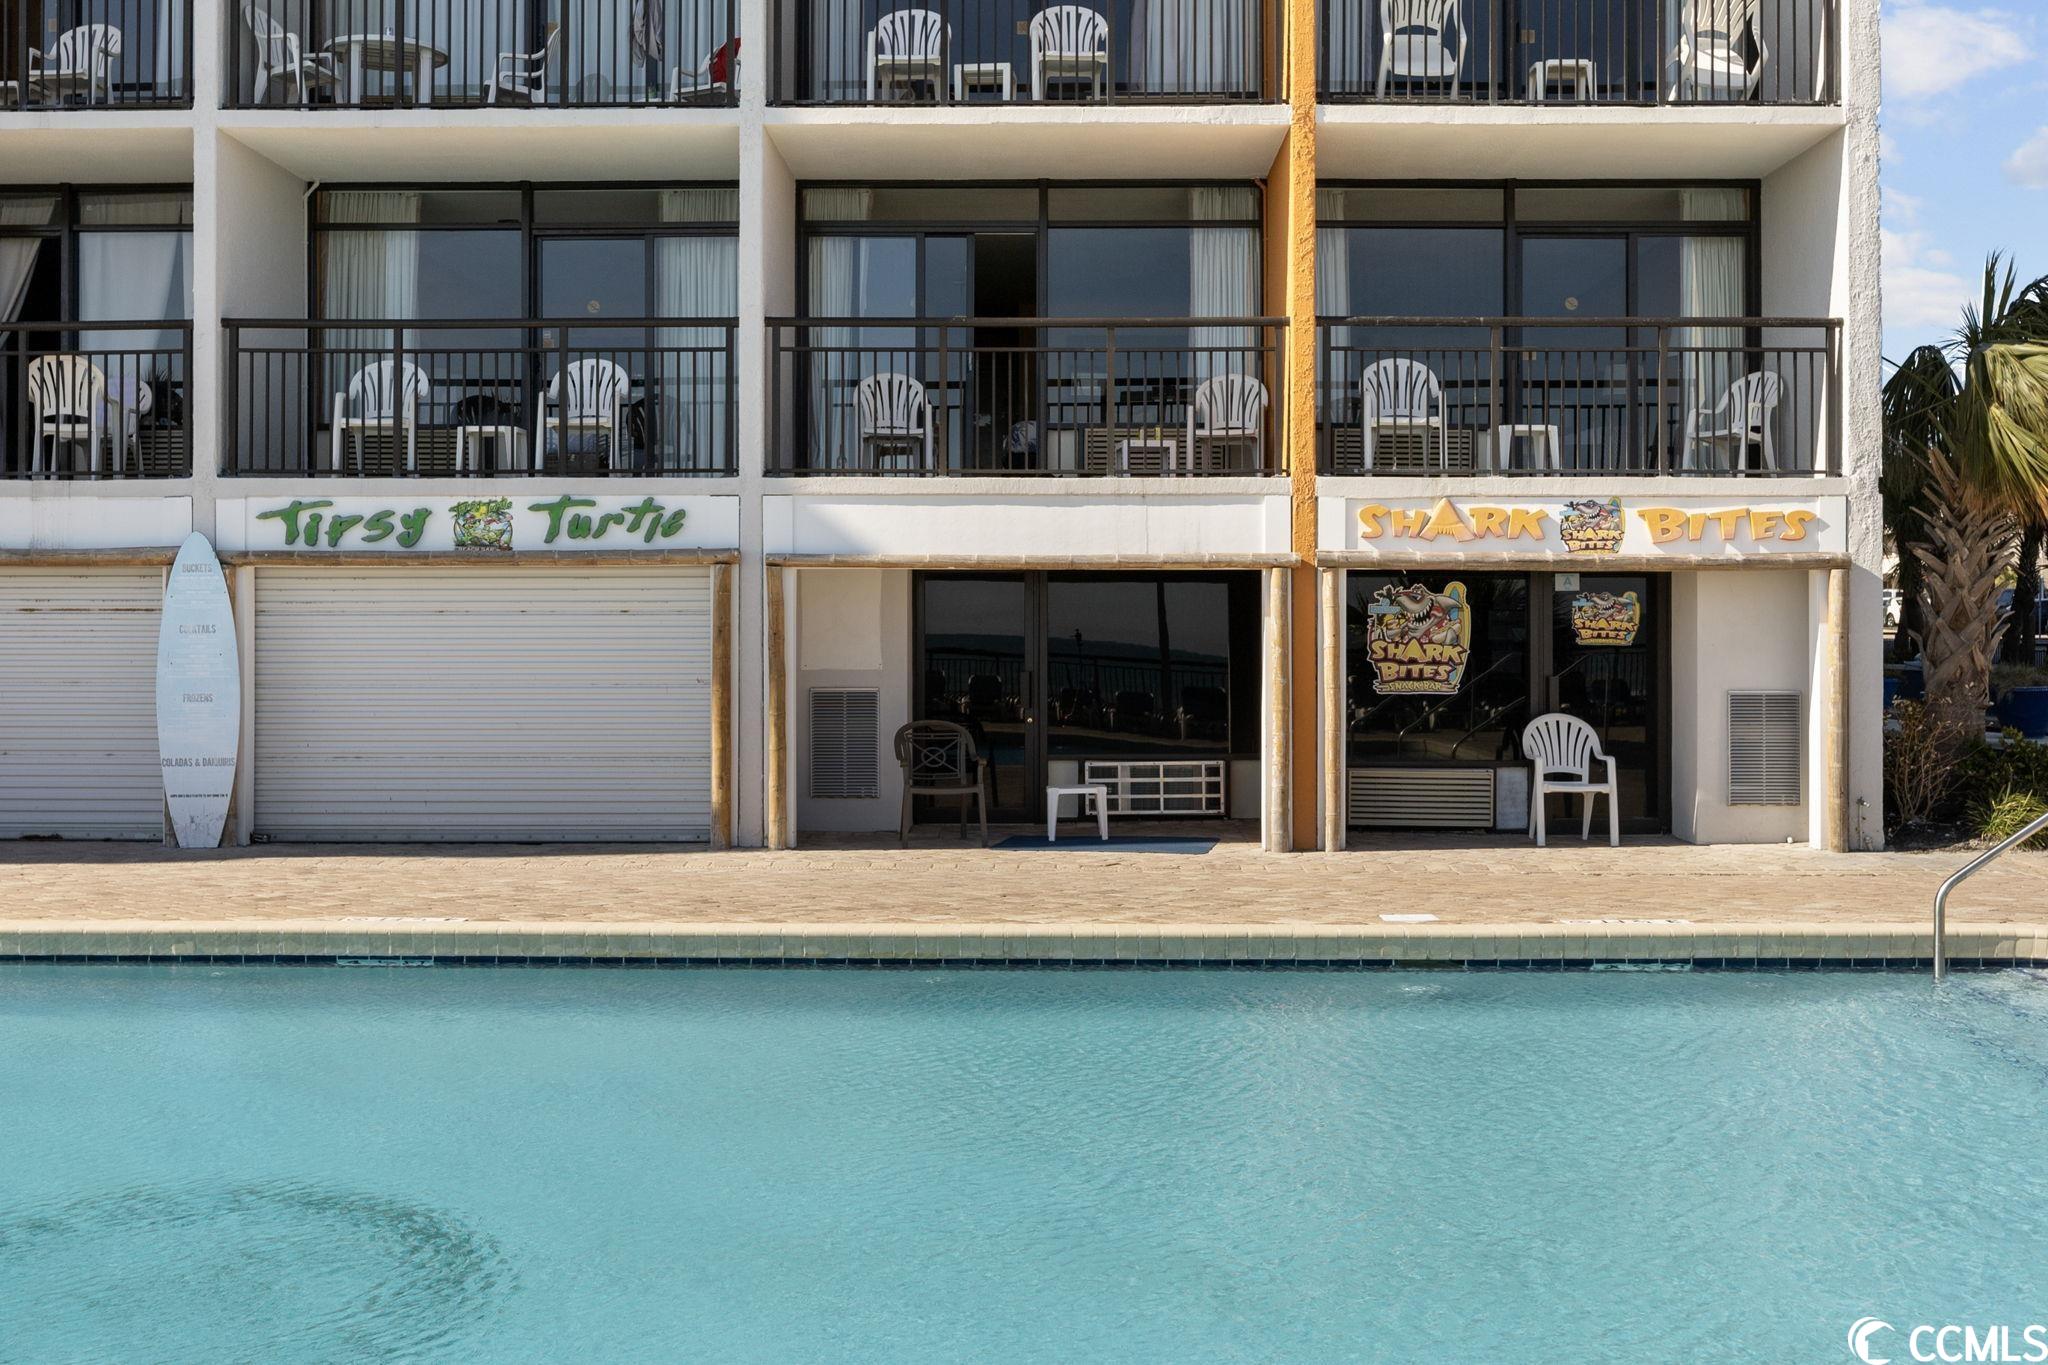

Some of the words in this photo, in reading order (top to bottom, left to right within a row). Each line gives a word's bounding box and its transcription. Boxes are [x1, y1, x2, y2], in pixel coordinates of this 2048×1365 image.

[256, 500, 433, 548] Tipsy
[528, 494, 687, 544] Turtle
[1358, 497, 1549, 542] SHARK
[1636, 507, 1817, 544] BITES
[1561, 527, 1622, 541] SHARK
[1566, 540, 1616, 551] BITES
[182, 563, 213, 573] BUCKETS
[1573, 618, 1635, 631] SHARK
[1579, 629, 1627, 640] BITES
[1371, 638, 1464, 663] SHARK
[1378, 661, 1452, 681] BITES
[161, 758, 193, 768] COLADAS
